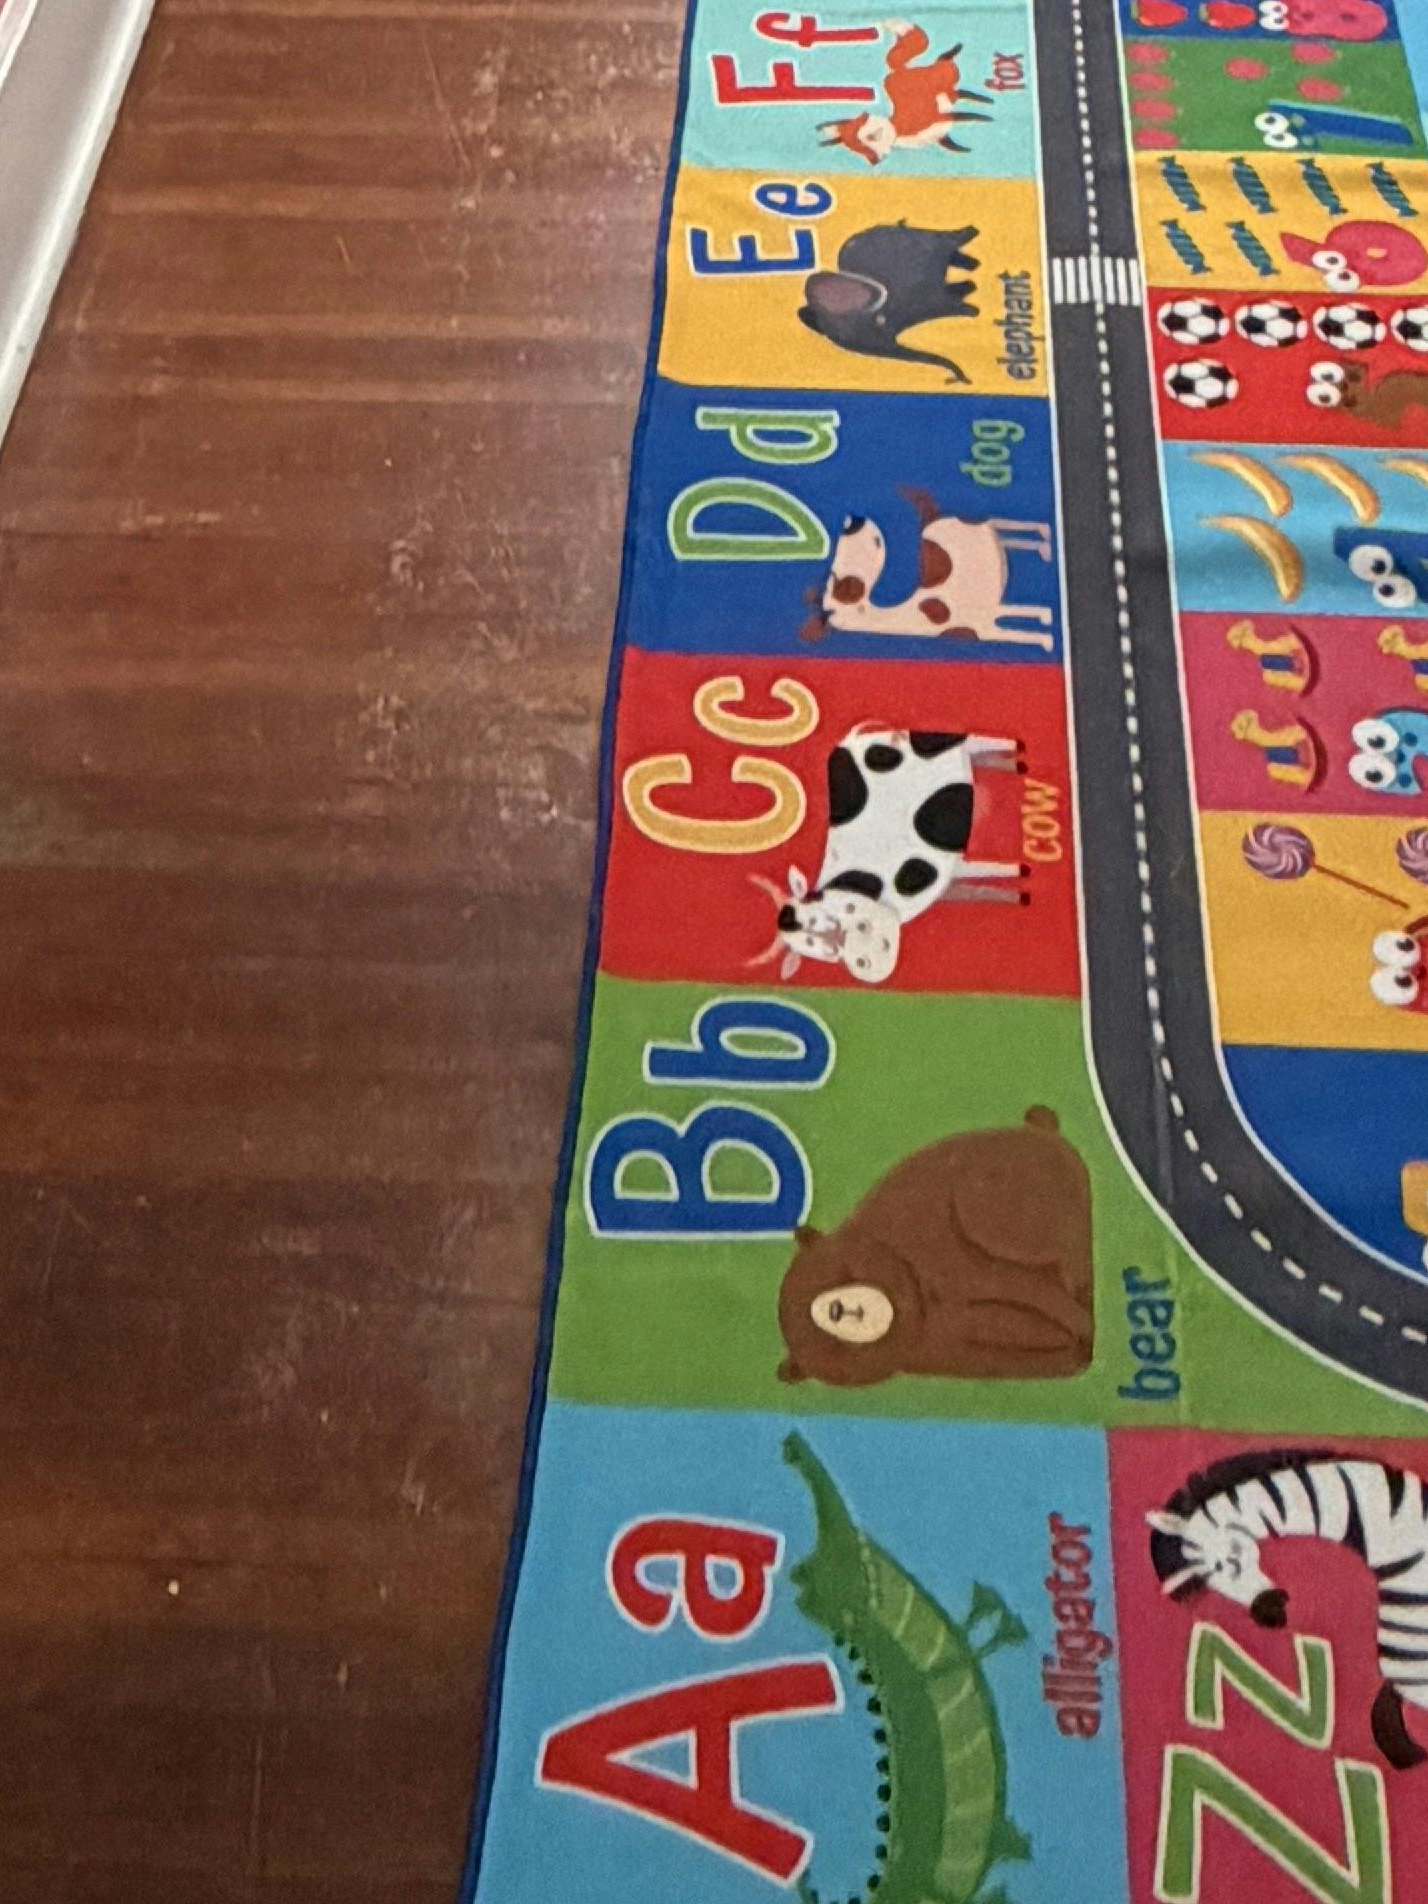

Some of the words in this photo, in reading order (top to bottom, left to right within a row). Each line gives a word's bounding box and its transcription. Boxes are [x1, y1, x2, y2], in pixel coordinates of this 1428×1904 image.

[708, 10, 889, 110] Ff
[983, 50, 1027, 94] fox
[684, 174, 834, 282] Ee
[1005, 270, 1037, 383] elephant
[665, 405, 844, 565] Dd
[960, 417, 1026, 489] dog
[621, 673, 822, 855] Cc
[1020, 777, 1064, 867] cow
[582, 992, 838, 1242] Bb
[1113, 1266, 1184, 1404] bear
[1039, 1511, 1119, 1744] alligator
[534, 1511, 847, 1889] Aa
[1150, 1620, 1394, 1904] Zz
